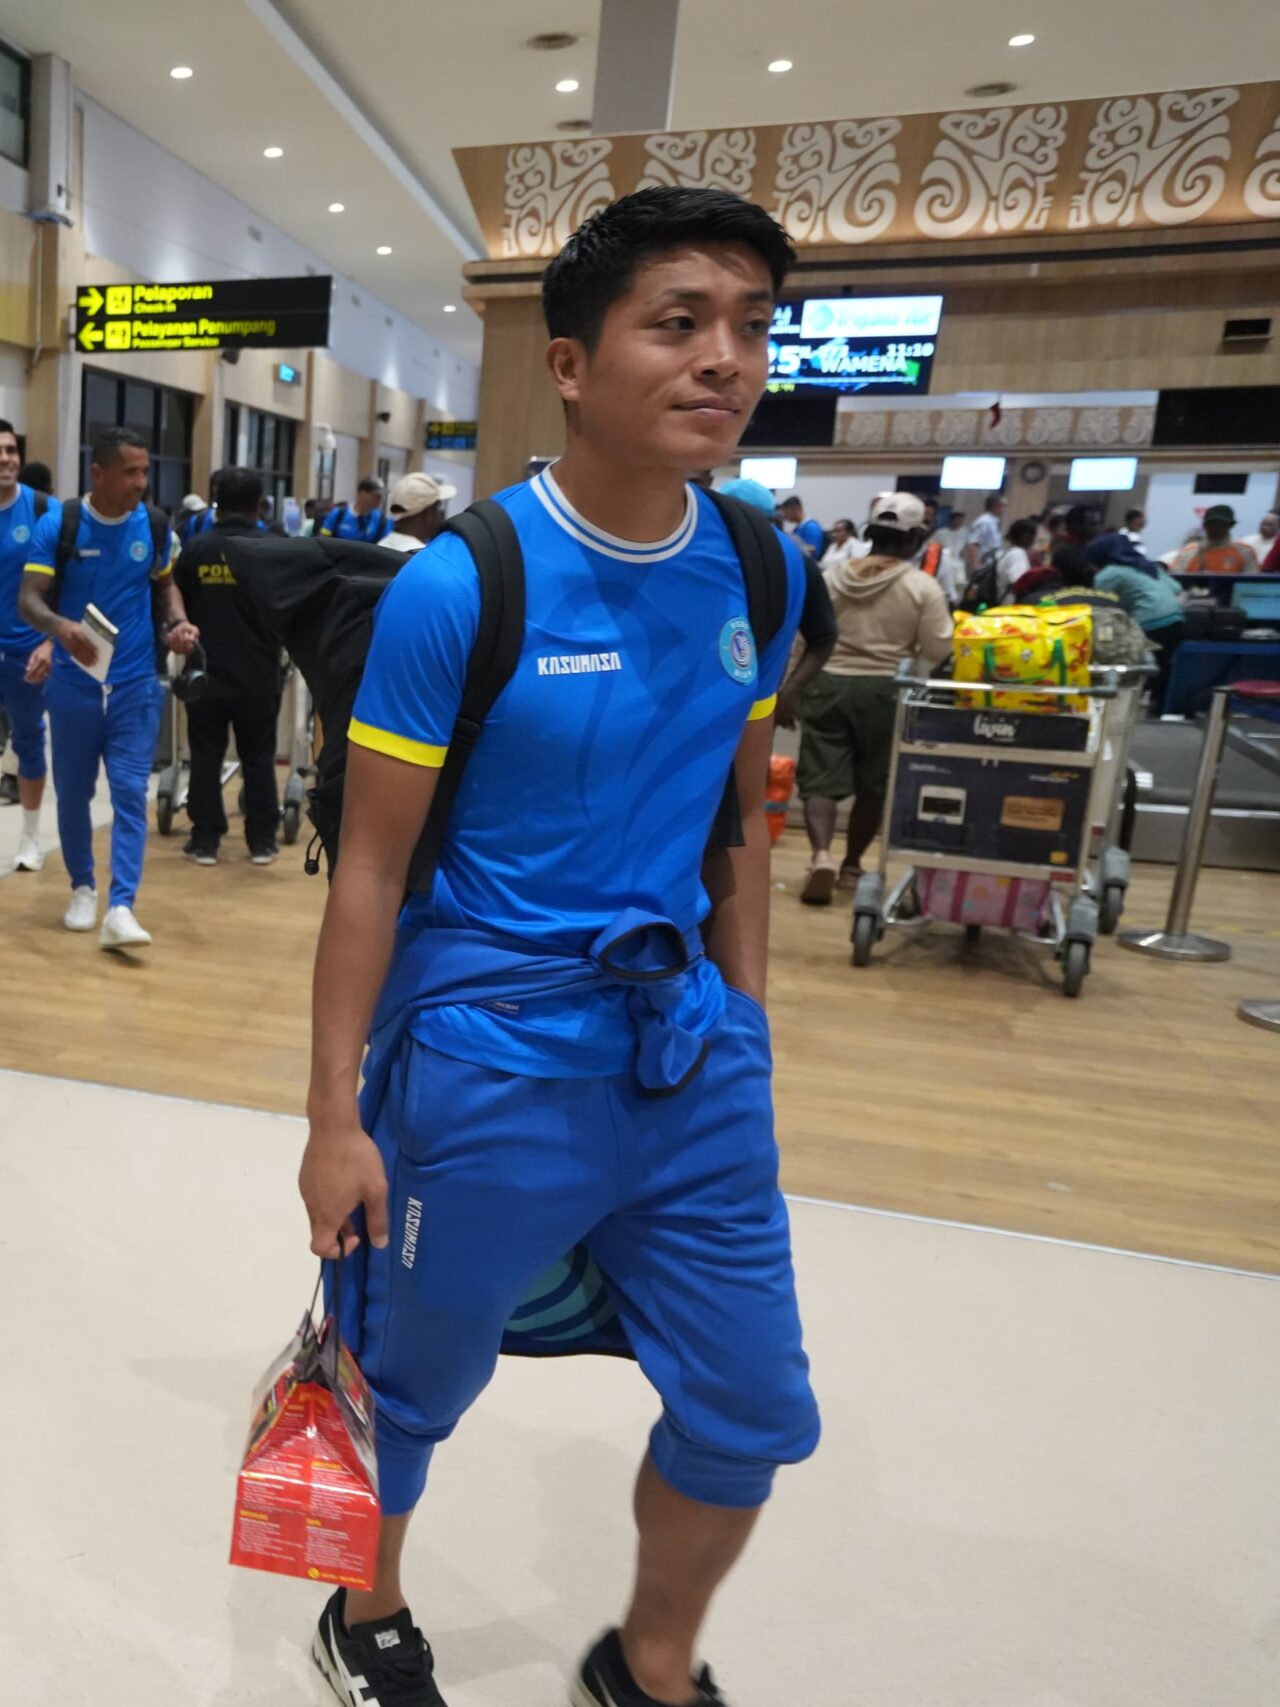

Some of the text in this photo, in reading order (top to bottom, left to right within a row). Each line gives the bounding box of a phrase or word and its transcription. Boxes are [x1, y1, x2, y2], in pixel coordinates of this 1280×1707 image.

[134, 285, 213, 304] Pelaporan
[132, 318, 276, 339] Pelayanan Penumpang
[821, 355, 907, 373] WAMENA
